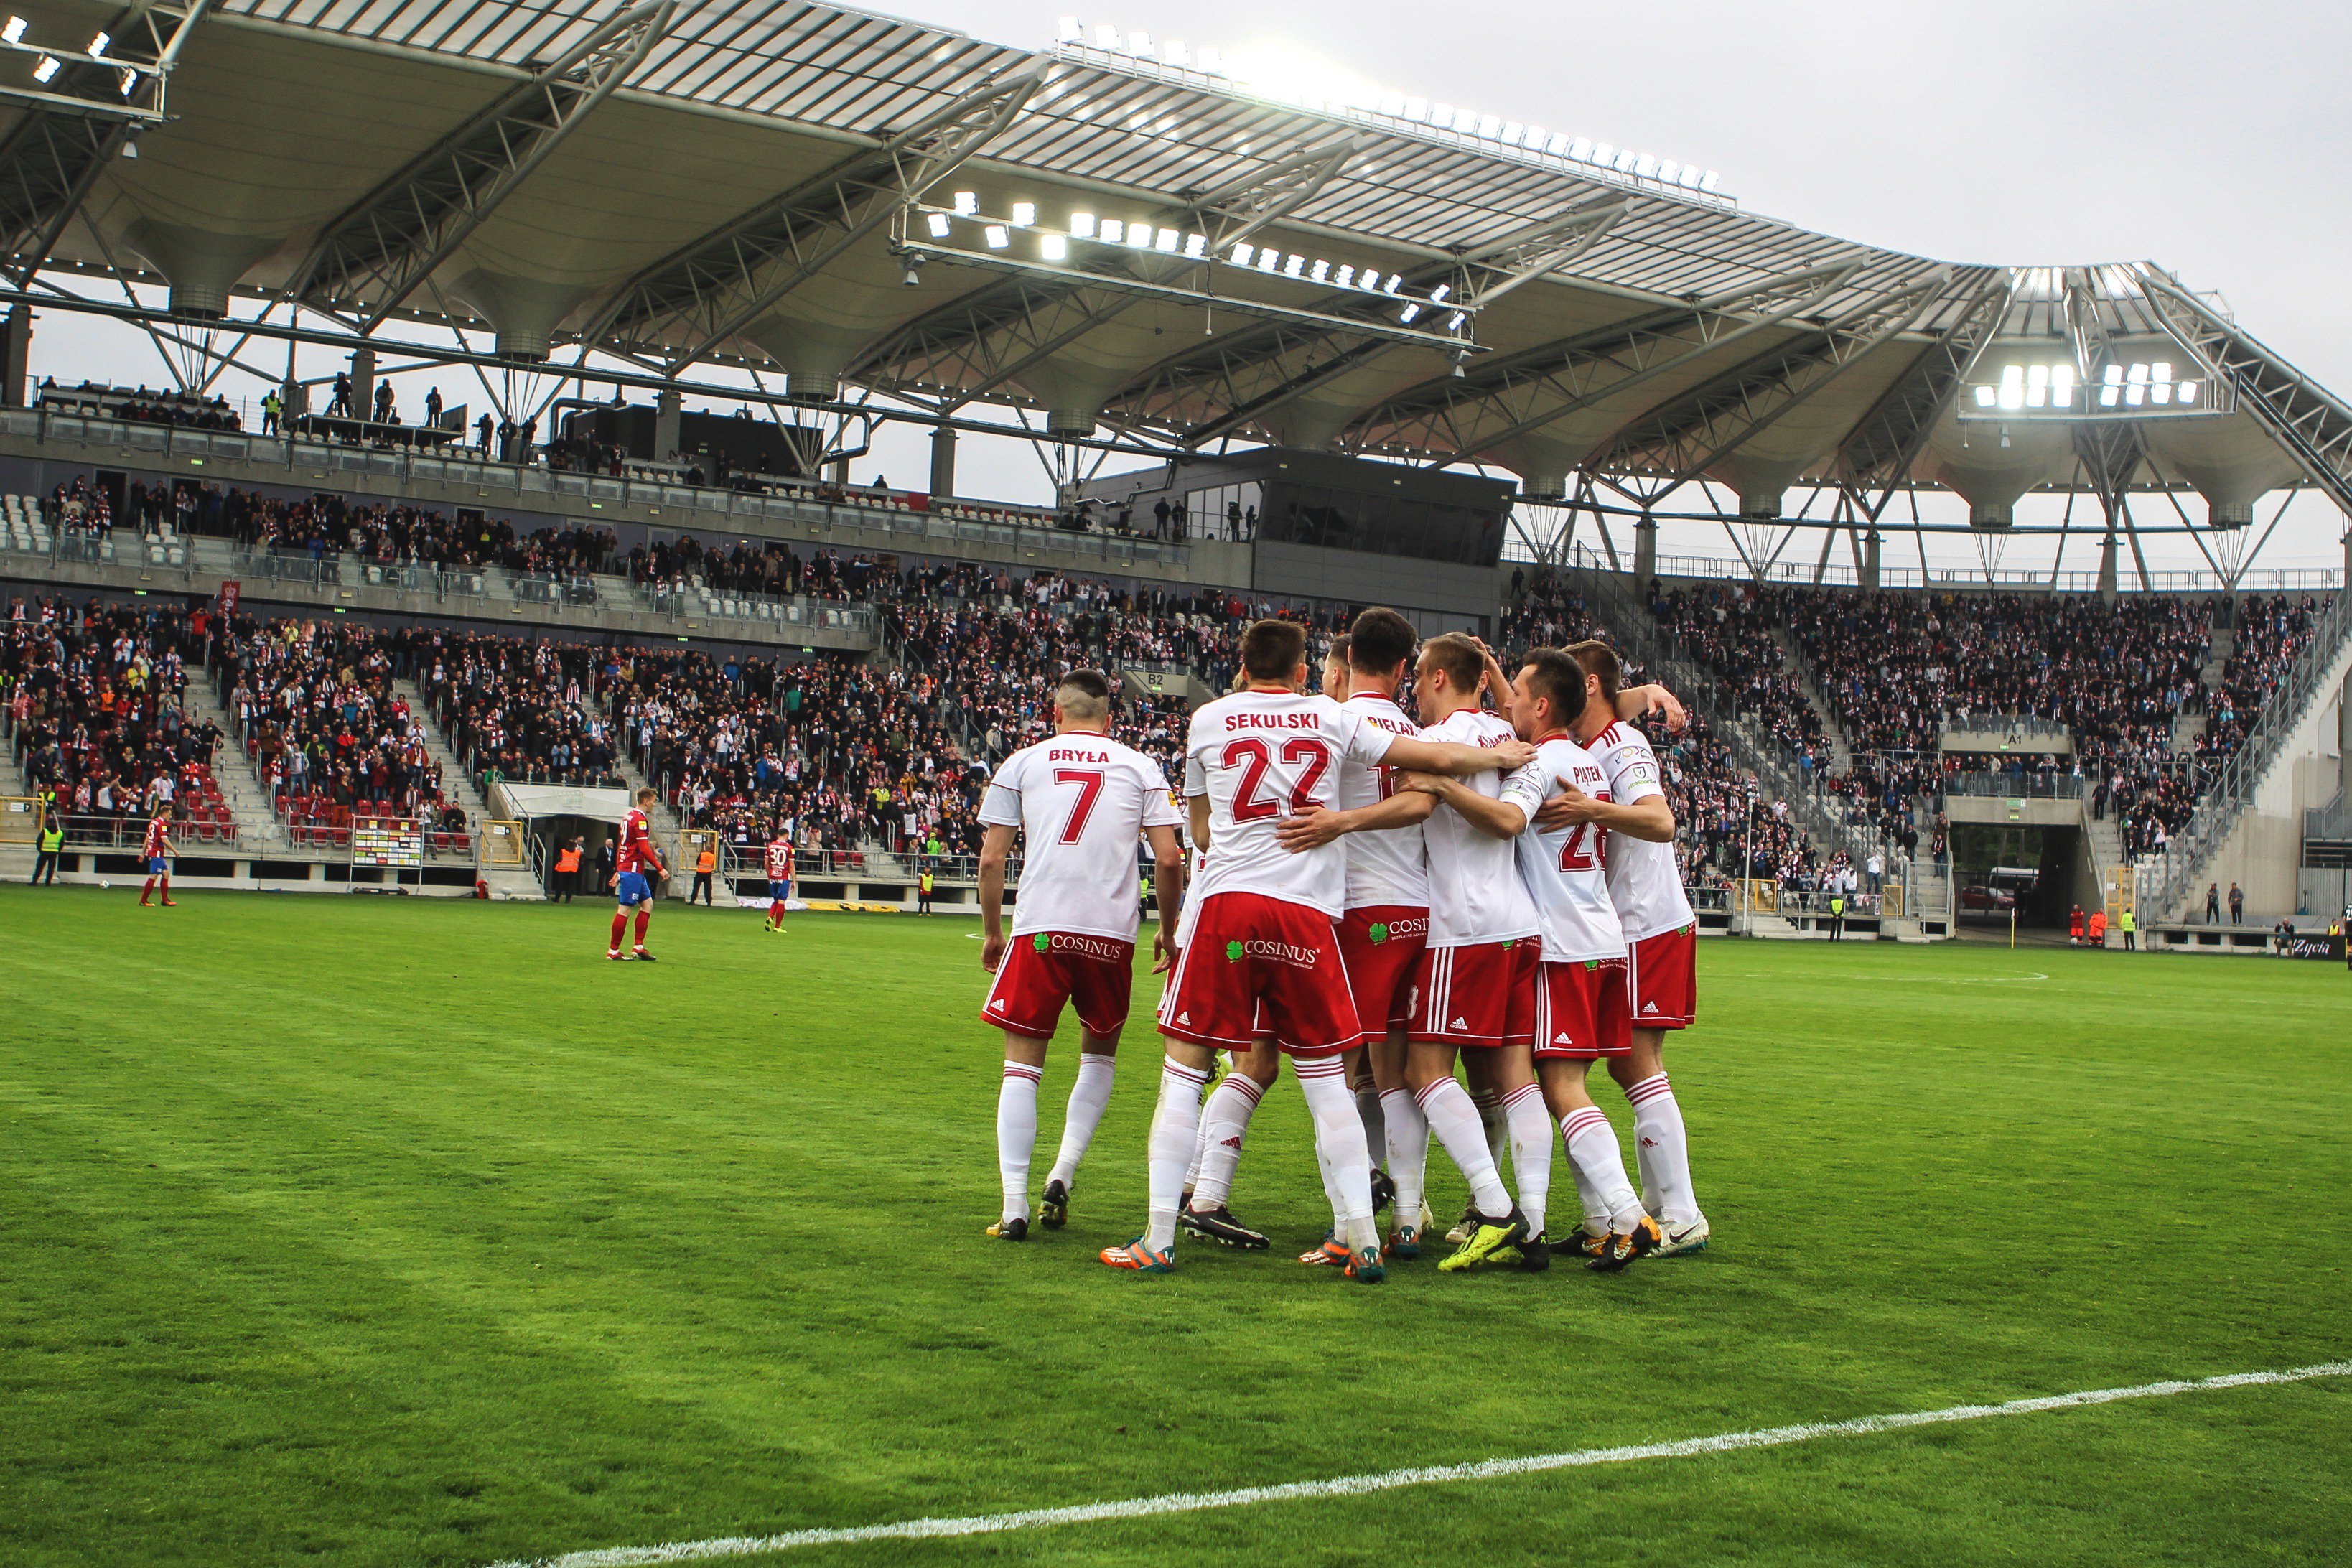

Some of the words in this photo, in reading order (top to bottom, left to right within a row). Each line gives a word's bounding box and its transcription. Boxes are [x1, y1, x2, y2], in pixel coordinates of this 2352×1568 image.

[1148, 673, 1163, 685] B2
[1226, 713, 1319, 732] SEKULSKI
[2008, 734, 2021, 745] A1
[1049, 749, 1110, 763] BRYŁA
[1220, 736, 1332, 825] 22
[1573, 765, 1605, 787] PIĄTEK
[1053, 767, 1105, 845] 7
[770, 849, 787, 866] 30
[1389, 918, 1429, 934] COSI
[1051, 935, 1121, 958] COSINUS
[1244, 940, 1316, 963] COSINUS
